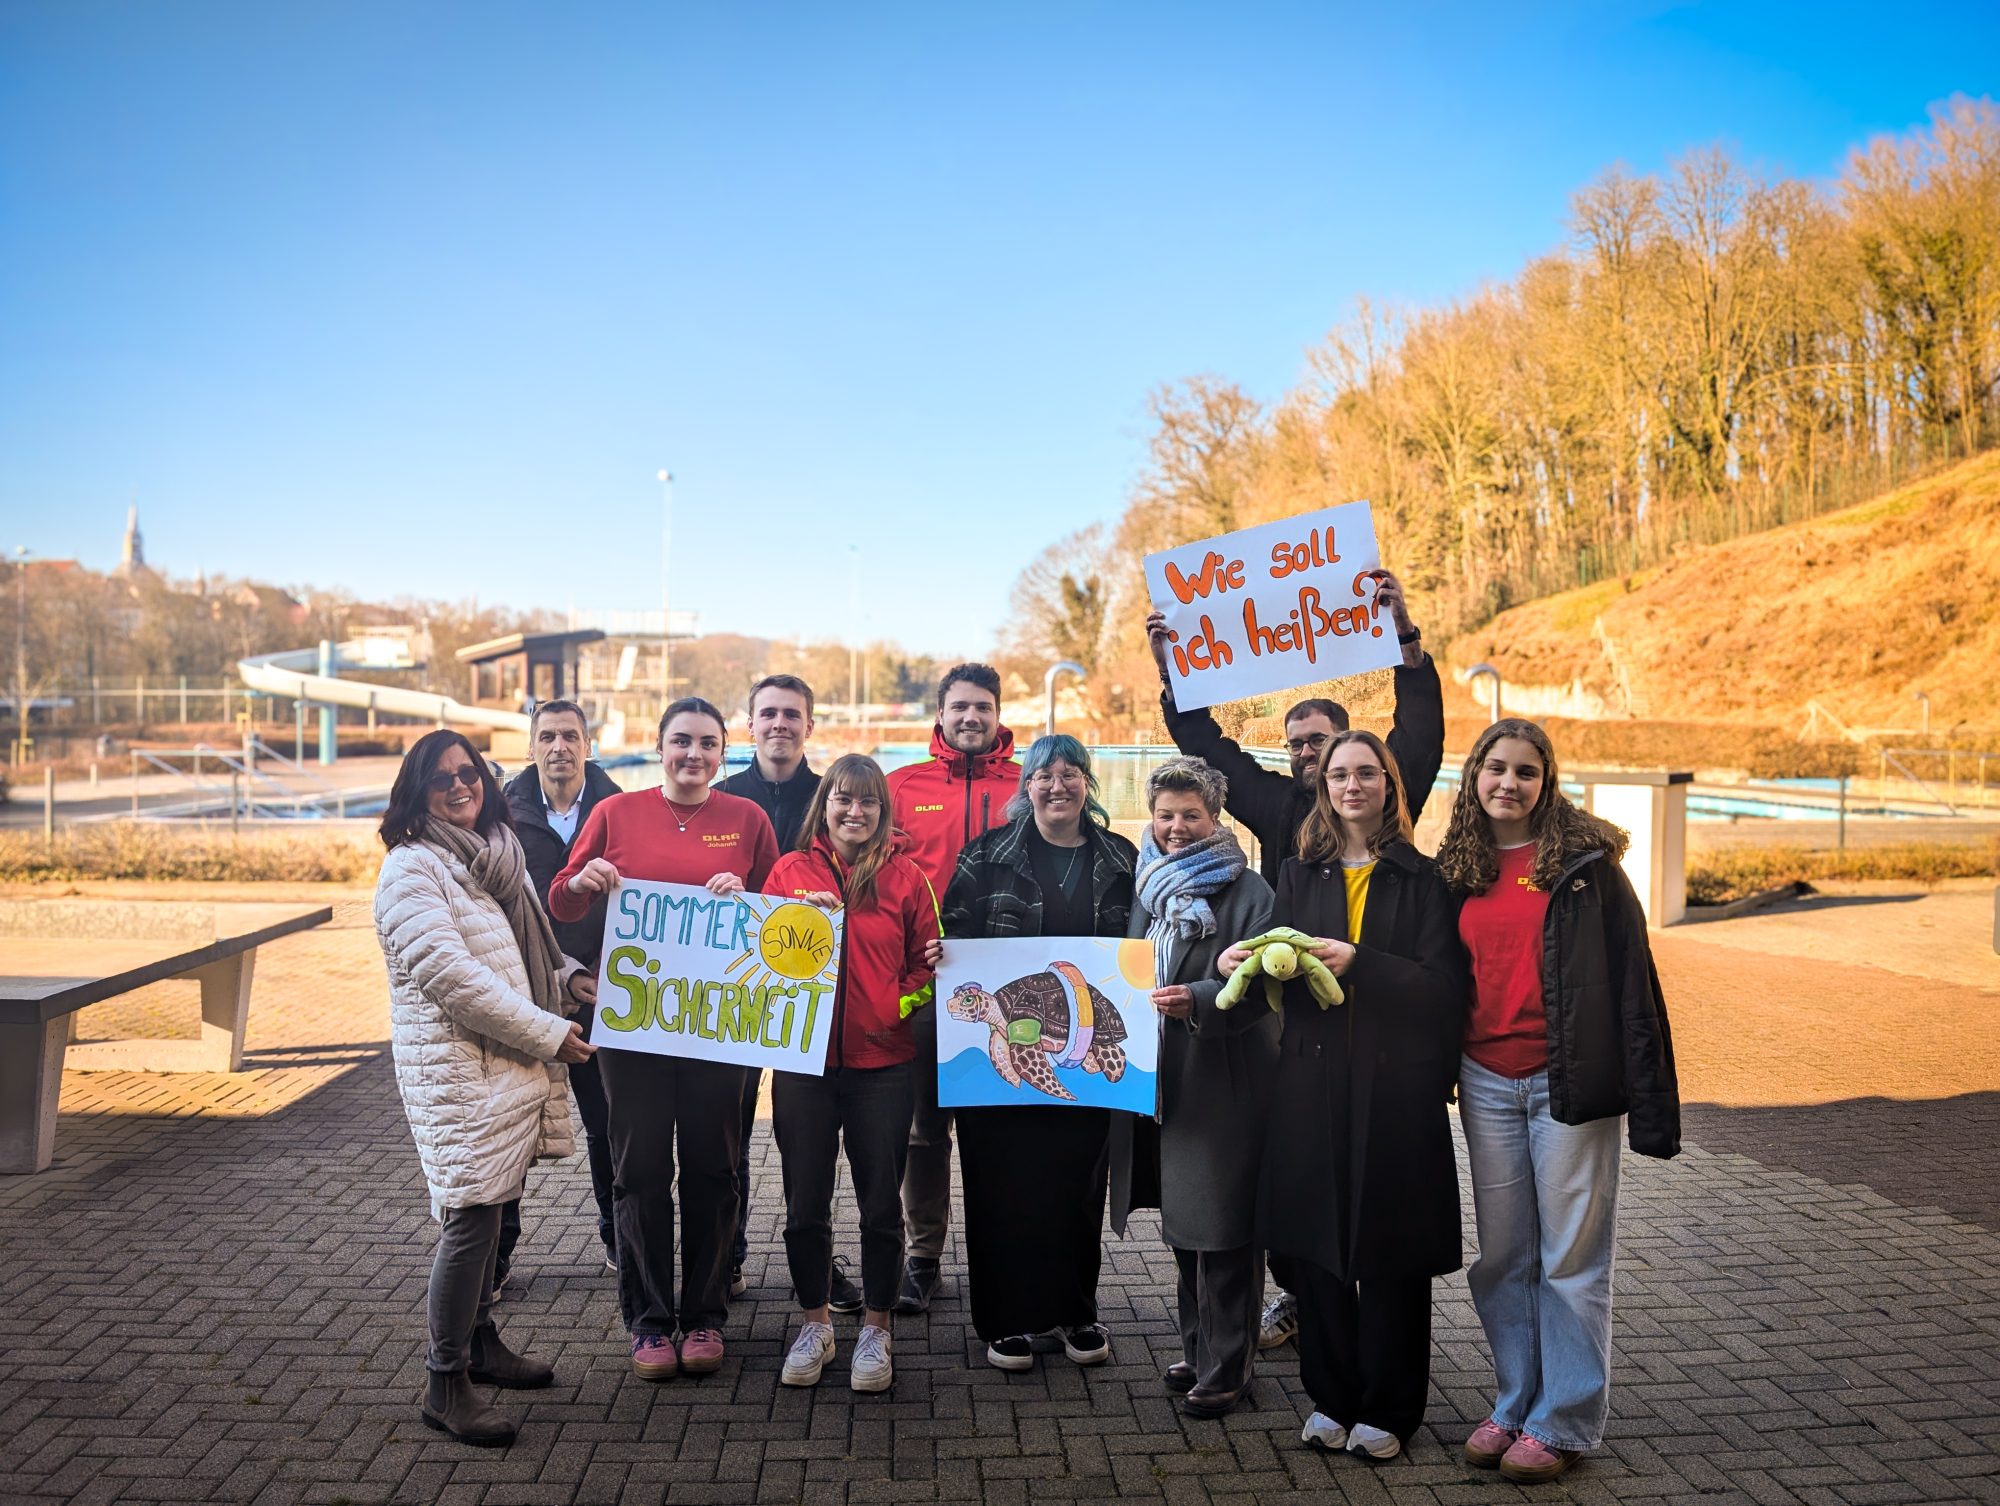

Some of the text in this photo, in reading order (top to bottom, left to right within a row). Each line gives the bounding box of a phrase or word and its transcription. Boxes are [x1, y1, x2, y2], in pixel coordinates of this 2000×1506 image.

[1165, 526, 1341, 604] Wie soll
[1167, 615, 1233, 677] ich
[702, 833, 740, 842] DLRG
[615, 888, 750, 951] SOMMER
[763, 925, 832, 963] SONNE
